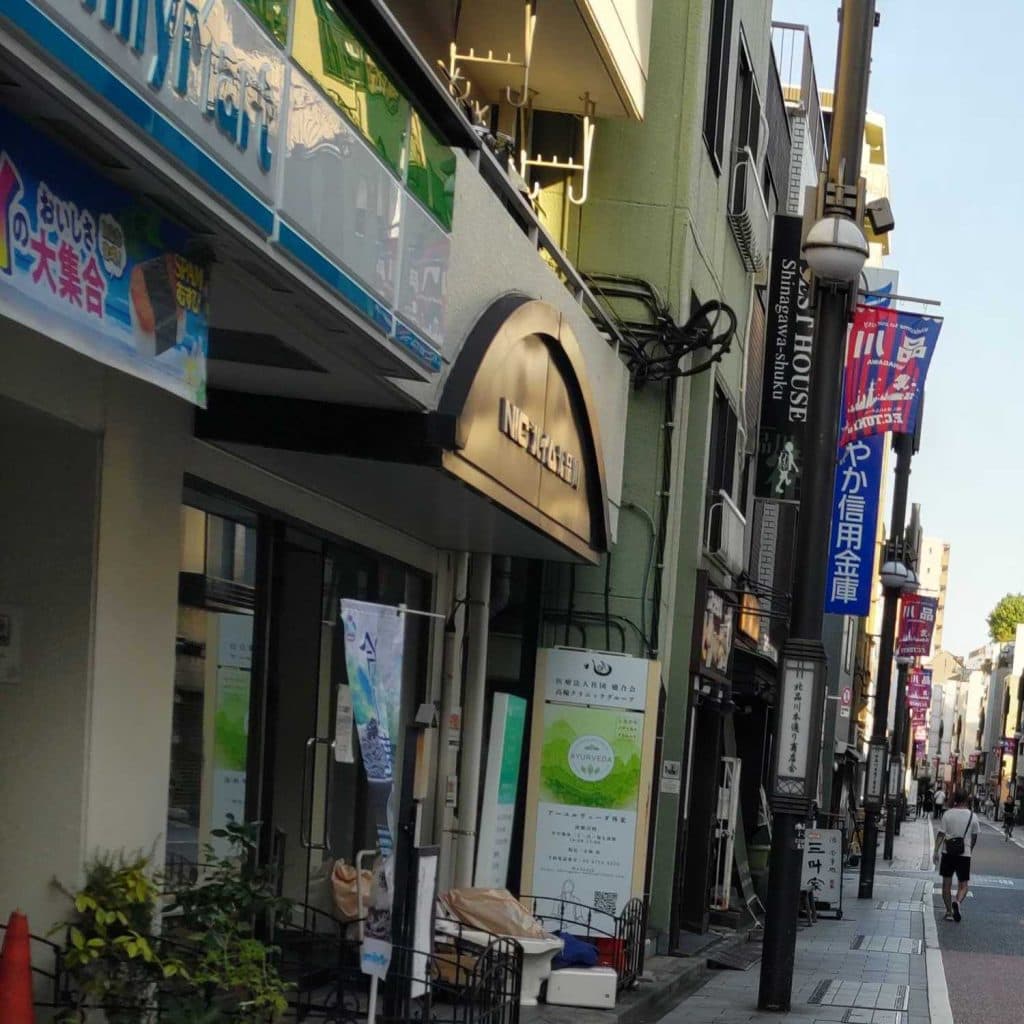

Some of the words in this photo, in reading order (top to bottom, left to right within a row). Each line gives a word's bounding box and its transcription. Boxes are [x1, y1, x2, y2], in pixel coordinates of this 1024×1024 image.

[39, 190, 94, 251] おいしさ
[31, 229, 106, 318] 大集合
[772, 258, 797, 400] Shinagawa-shuku
[788, 333, 815, 423] HOUSE
